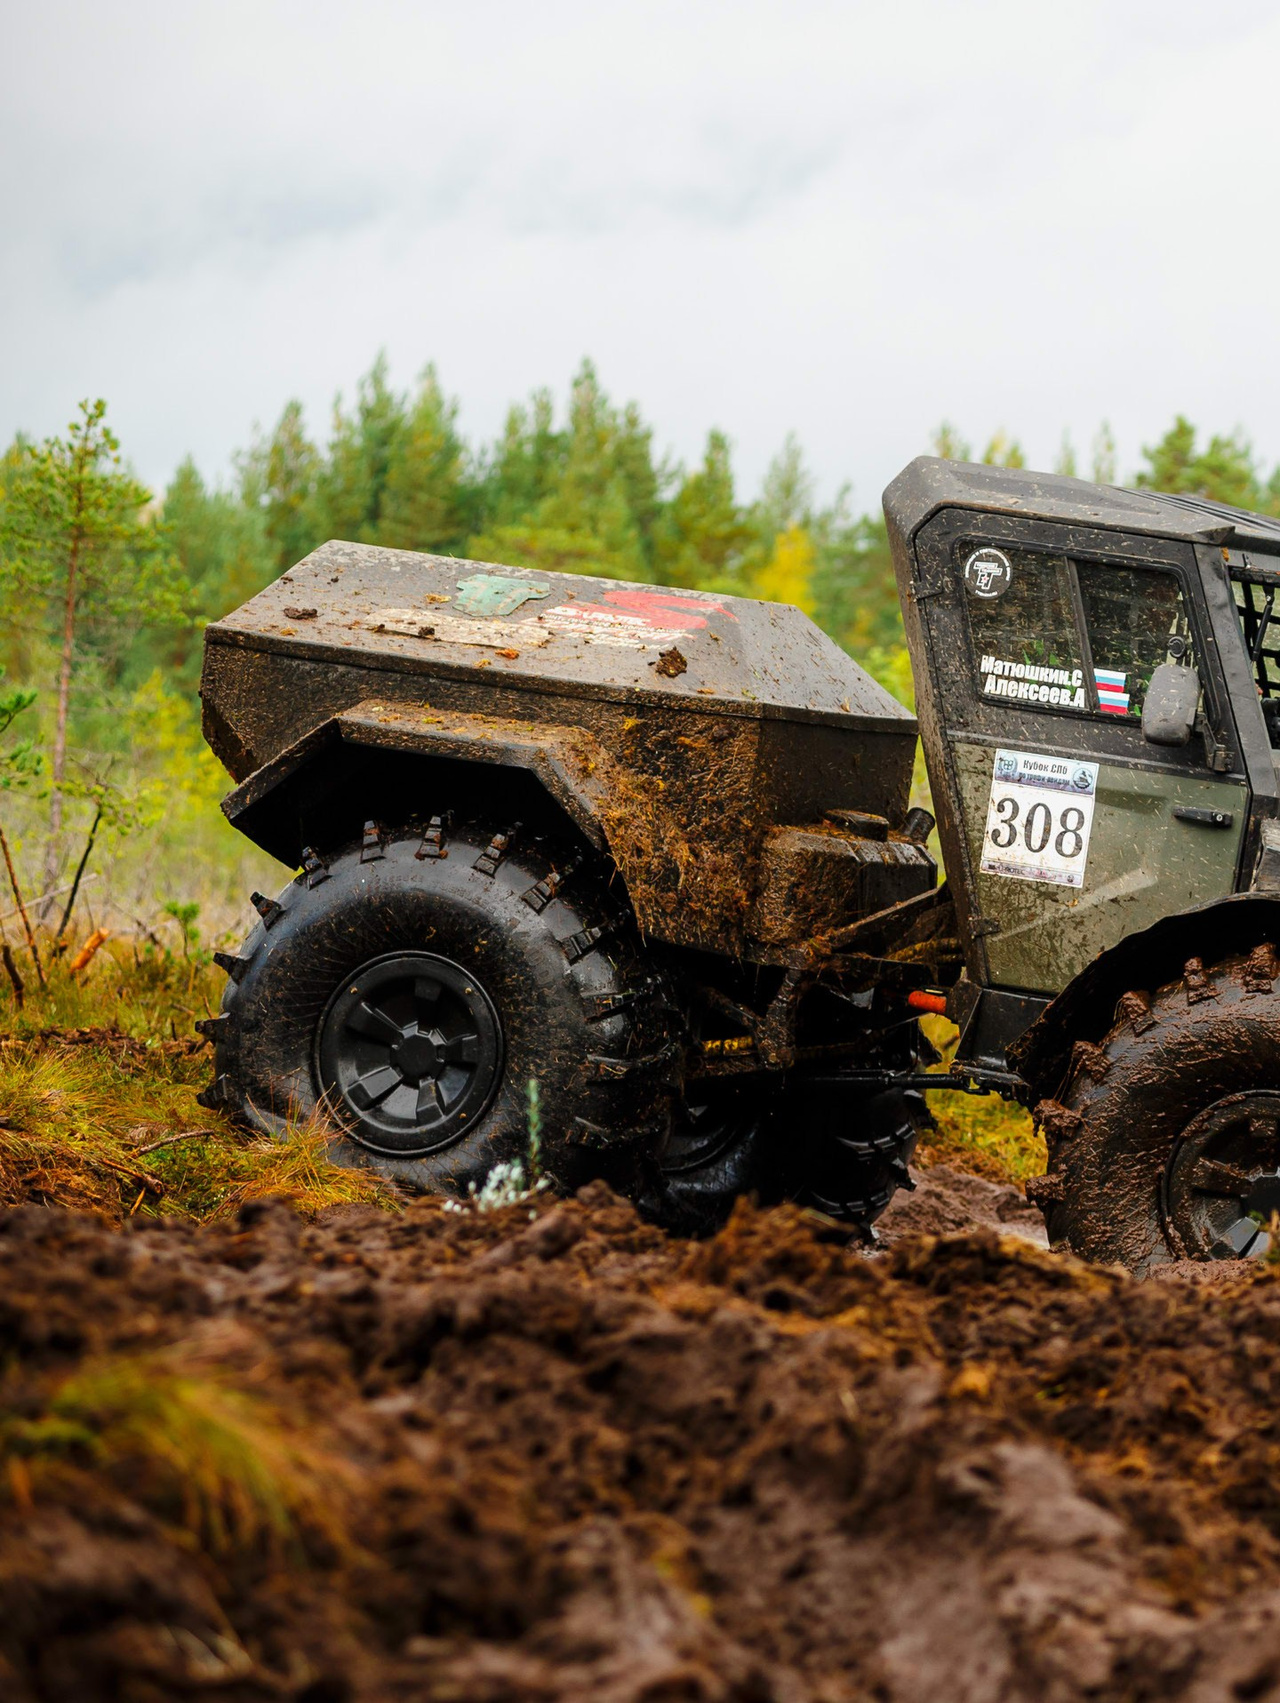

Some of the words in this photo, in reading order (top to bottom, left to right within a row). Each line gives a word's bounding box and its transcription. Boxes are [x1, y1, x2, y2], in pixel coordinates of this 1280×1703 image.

[980, 655, 1083, 687] Матюшкин.С
[984, 674, 1085, 708] Алексеев.А
[1023, 759, 1049, 772] Кубок
[991, 797, 1085, 858] 308
